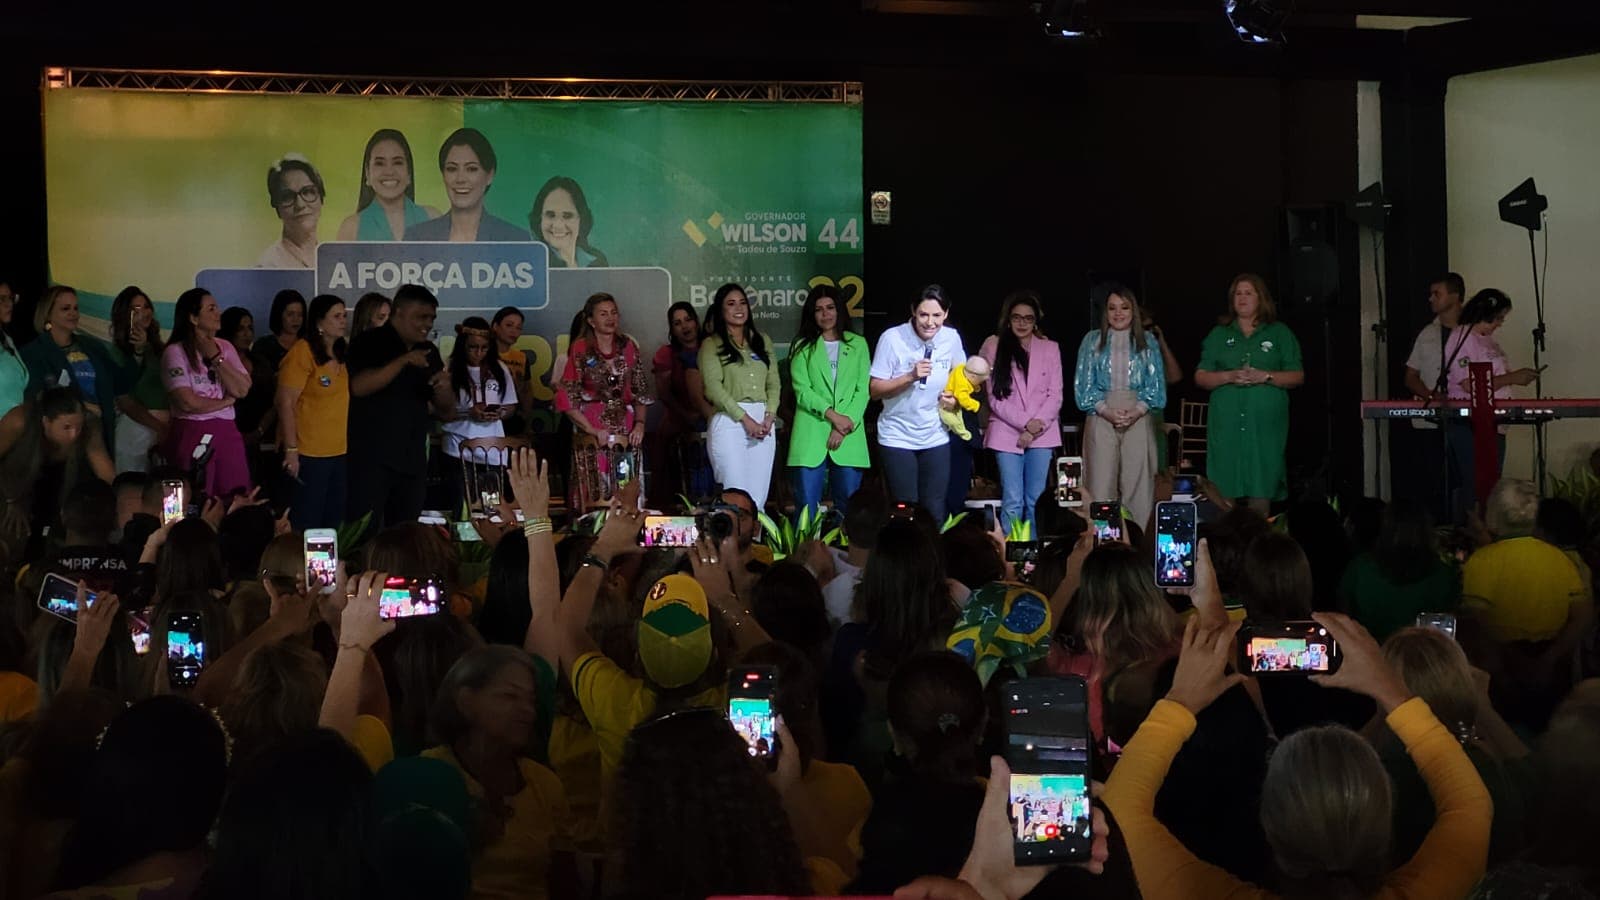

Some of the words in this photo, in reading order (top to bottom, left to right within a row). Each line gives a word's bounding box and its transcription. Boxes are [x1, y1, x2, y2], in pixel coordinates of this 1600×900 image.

[745, 212, 806, 221] GOVERNADOR
[721, 222, 807, 243] WILSON
[817, 218, 860, 249] 44
[737, 244, 766, 253] Tadeu
[767, 244, 779, 253] de
[780, 244, 807, 253] Souza
[328, 262, 353, 289] A
[357, 262, 467, 296] FORÇA
[471, 262, 535, 289] DAS
[710, 275, 792, 283] PRESIDENTE
